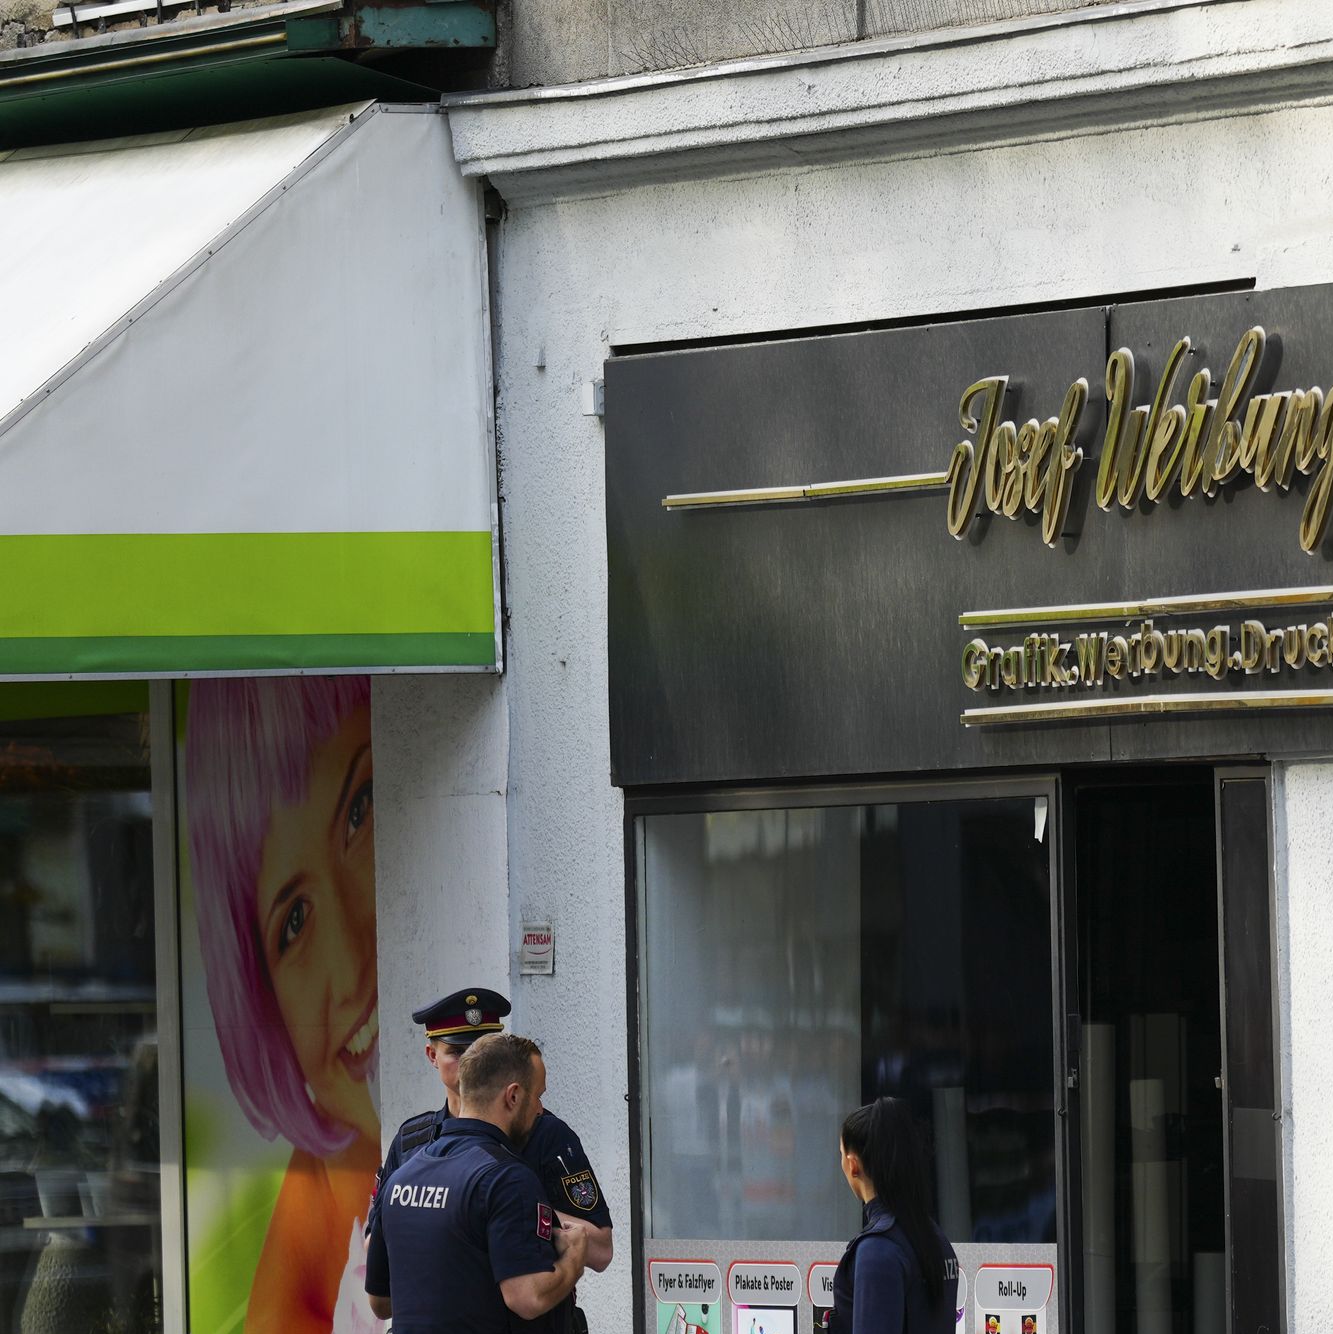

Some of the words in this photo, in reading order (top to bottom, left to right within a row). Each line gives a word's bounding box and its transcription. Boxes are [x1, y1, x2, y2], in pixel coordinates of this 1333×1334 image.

[947, 374, 1089, 548] Josef
[389, 1184, 450, 1209] POLIZEI
[658, 1273, 676, 1293] Flyer
[677, 1273, 684, 1289] &
[685, 1273, 715, 1293] Falzflyer
[735, 1275, 762, 1291] Plakate
[763, 1276, 770, 1290] &
[770, 1276, 794, 1291] Poster
[998, 1281, 1027, 1300] Roll-Up
